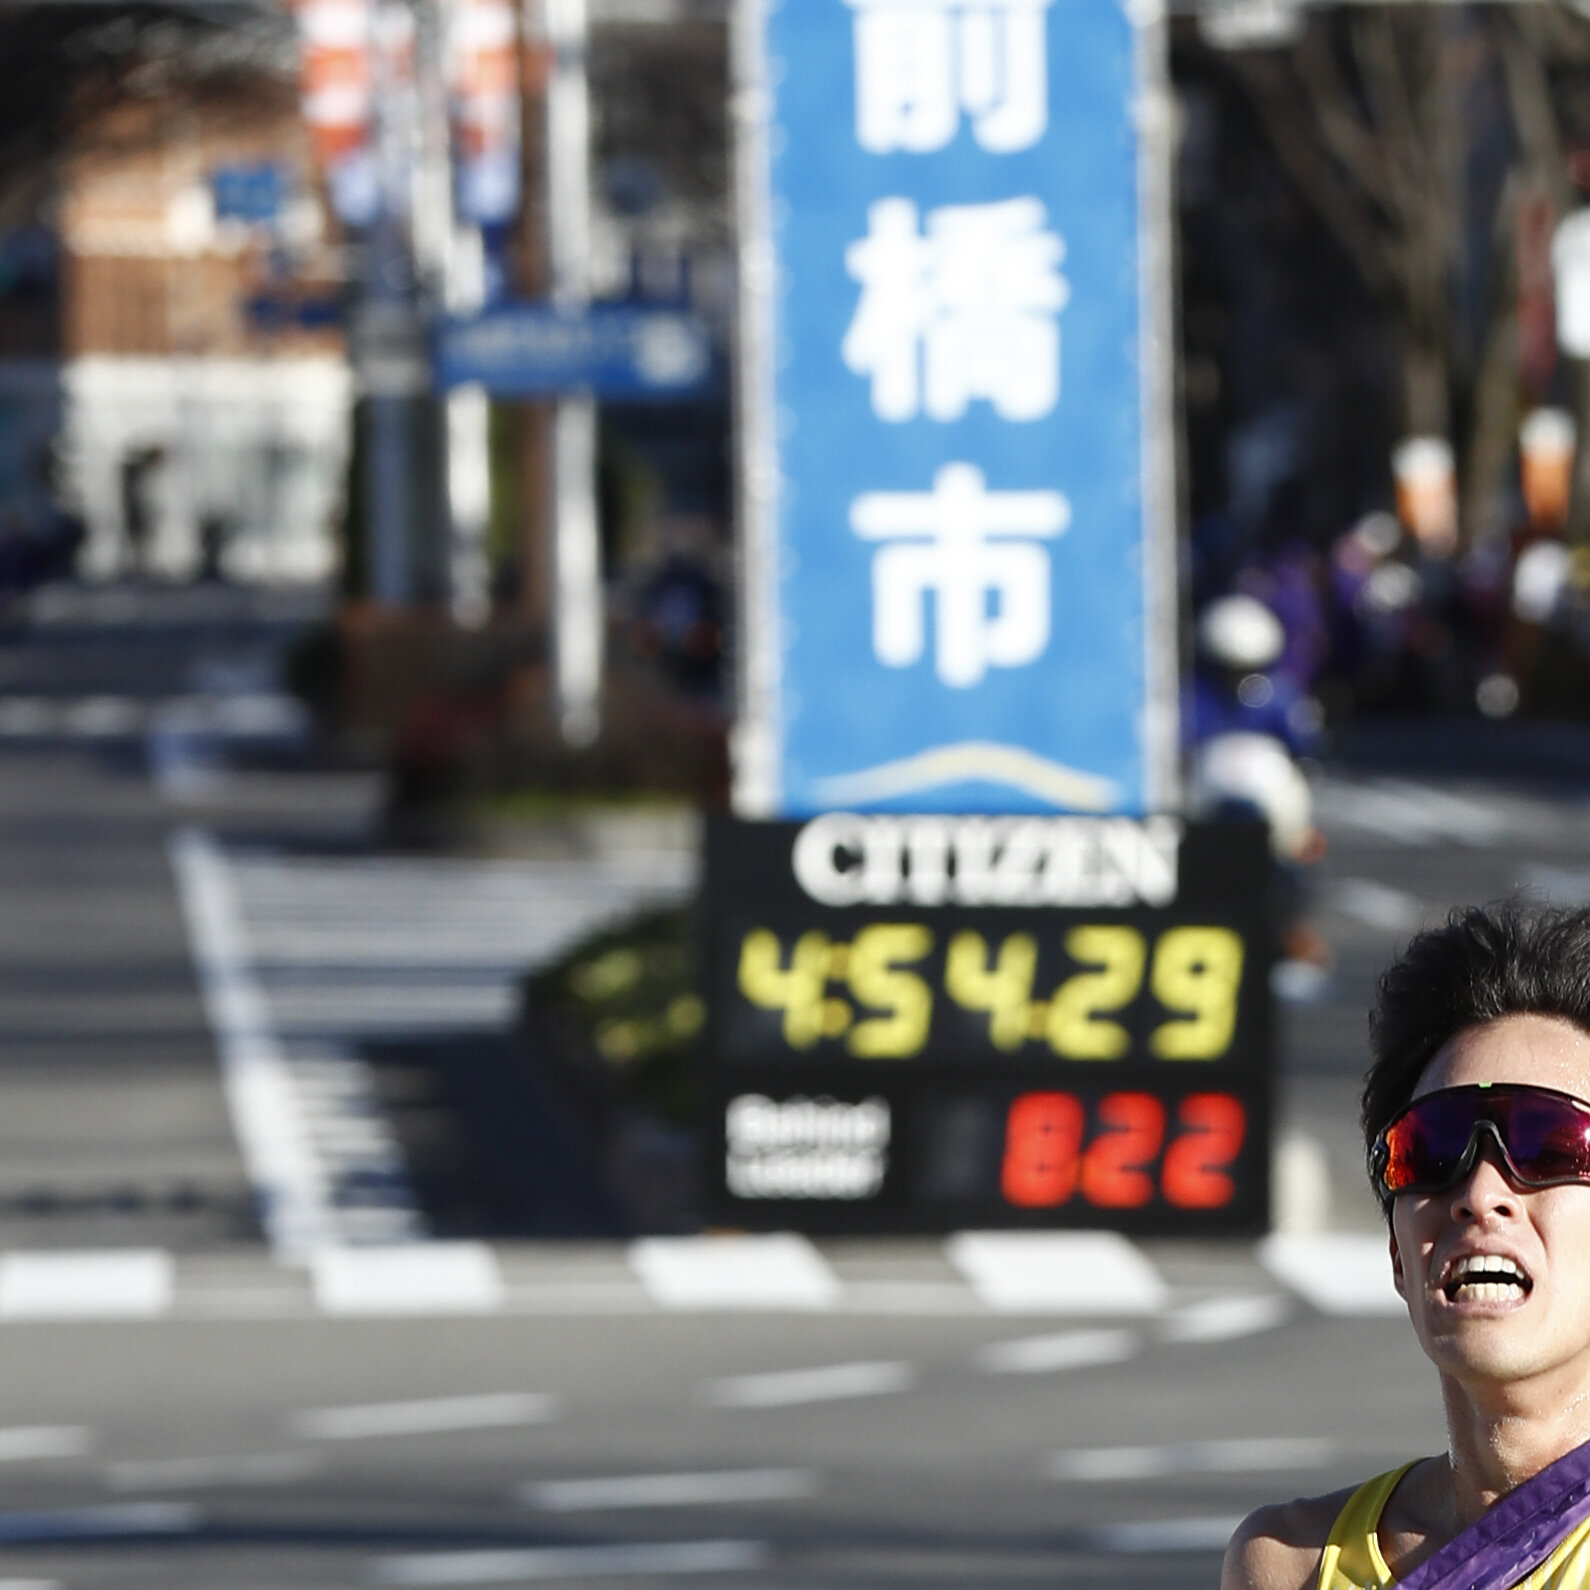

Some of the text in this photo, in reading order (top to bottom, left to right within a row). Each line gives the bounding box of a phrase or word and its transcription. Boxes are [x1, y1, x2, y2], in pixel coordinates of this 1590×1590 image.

[842, 0, 1072, 690] 前橋市
[792, 812, 1183, 906] CITIZEN
